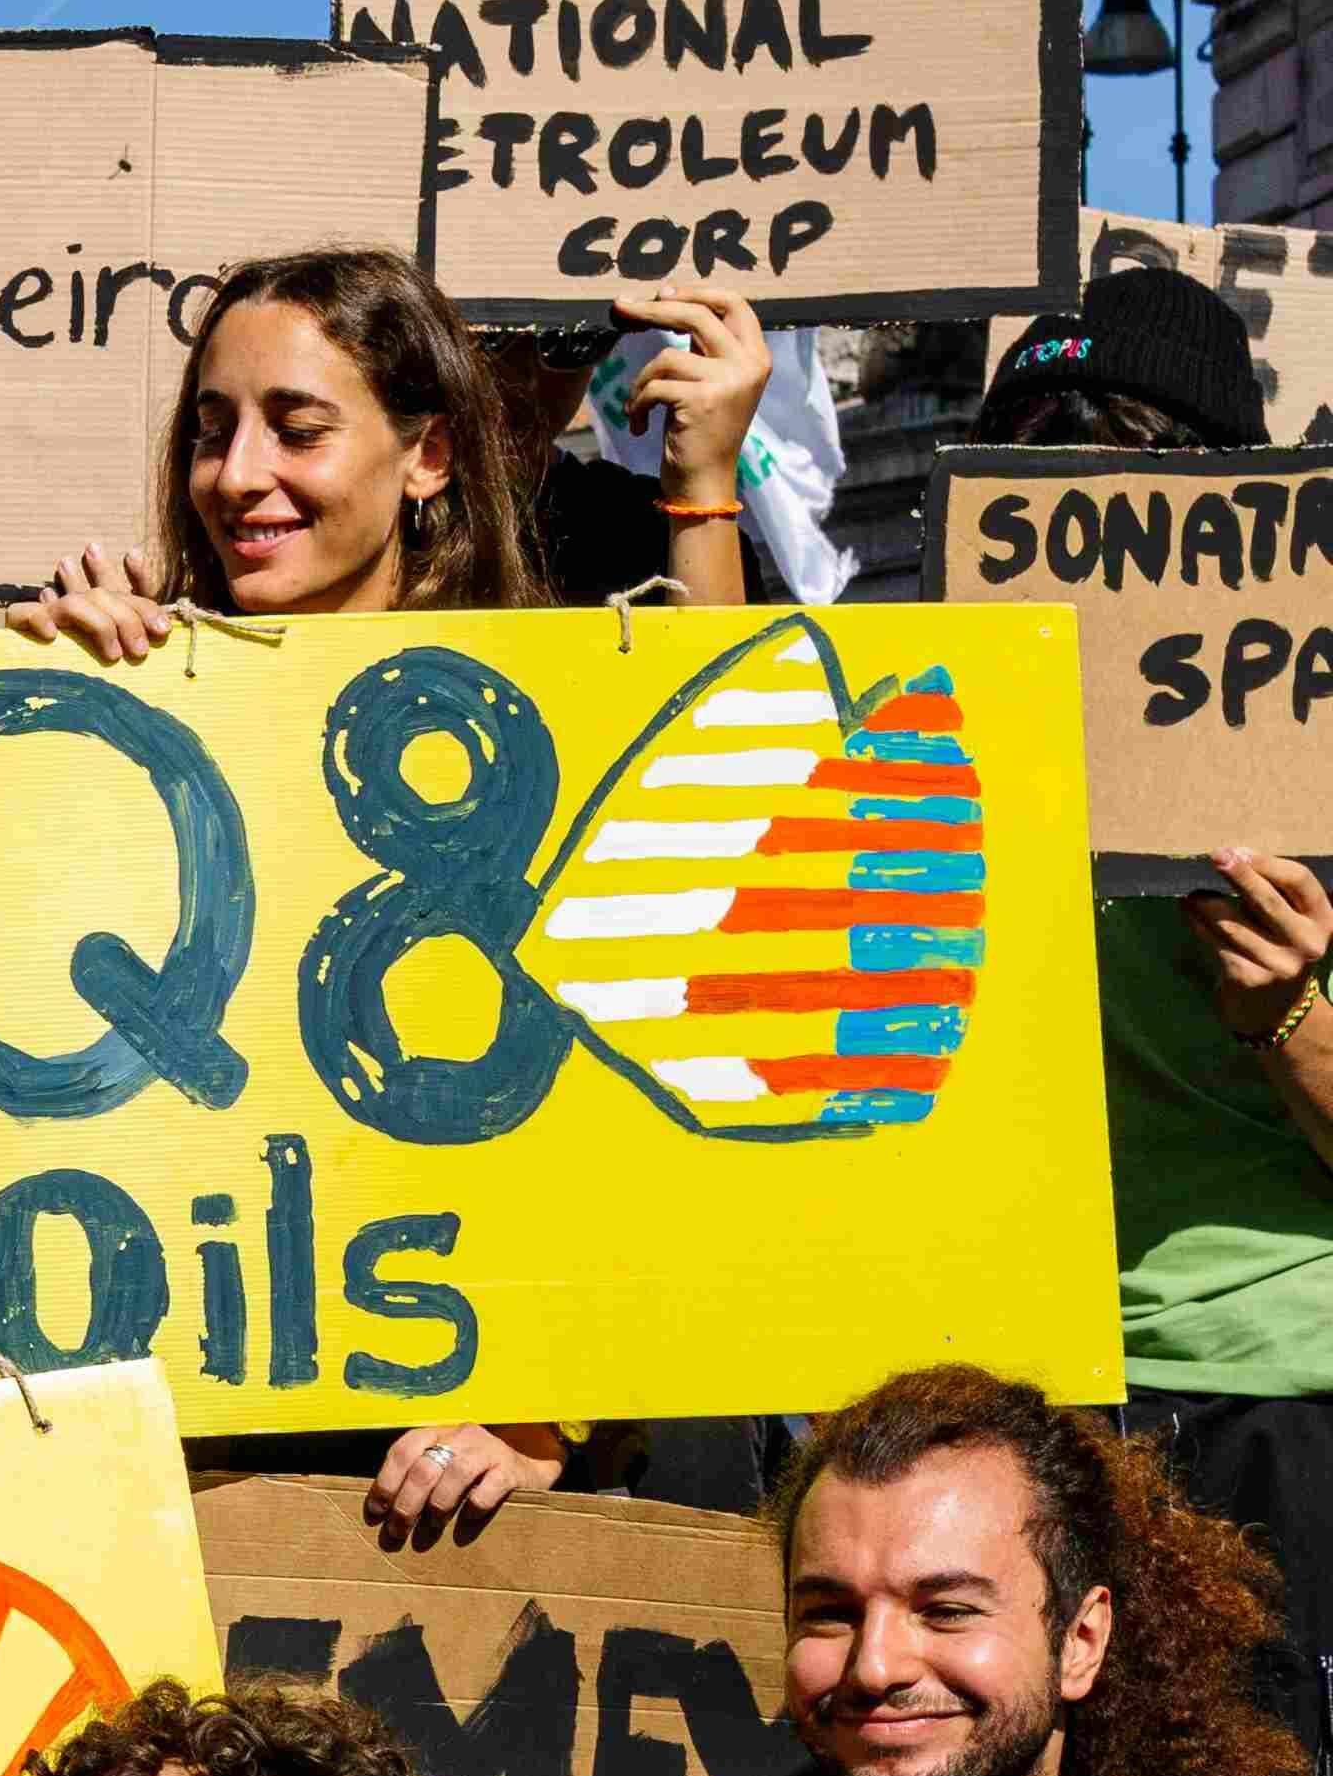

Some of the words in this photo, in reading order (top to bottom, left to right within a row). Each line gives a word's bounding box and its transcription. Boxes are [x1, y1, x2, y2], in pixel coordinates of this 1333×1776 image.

[435, 103, 938, 198] ETROLEUM
[558, 201, 835, 280] CORP
[979, 477, 1333, 592] SONATR
[1139, 619, 1333, 728] SPA
